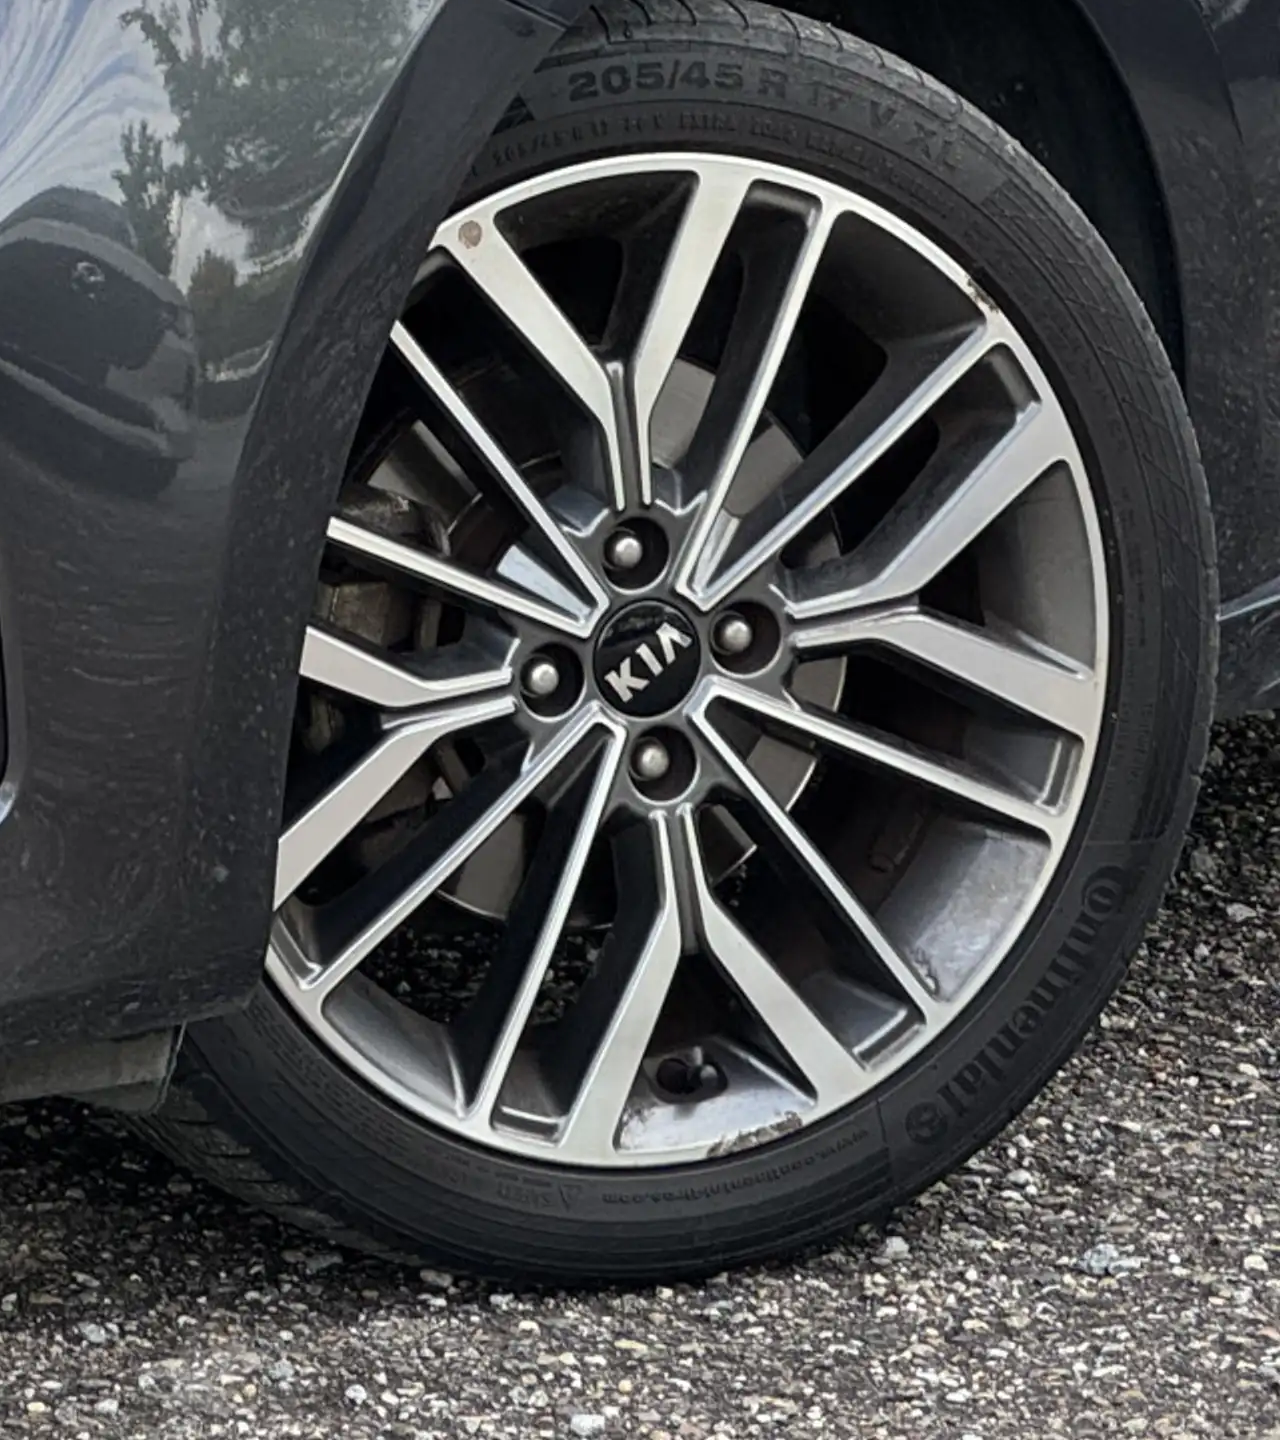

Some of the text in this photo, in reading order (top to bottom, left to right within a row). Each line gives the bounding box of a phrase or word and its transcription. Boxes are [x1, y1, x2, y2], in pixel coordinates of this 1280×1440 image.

[568, 60, 745, 102] 205/45
[757, 67, 788, 101] R
[604, 622, 693, 703] KIA
[936, 864, 1128, 1117] Continental
